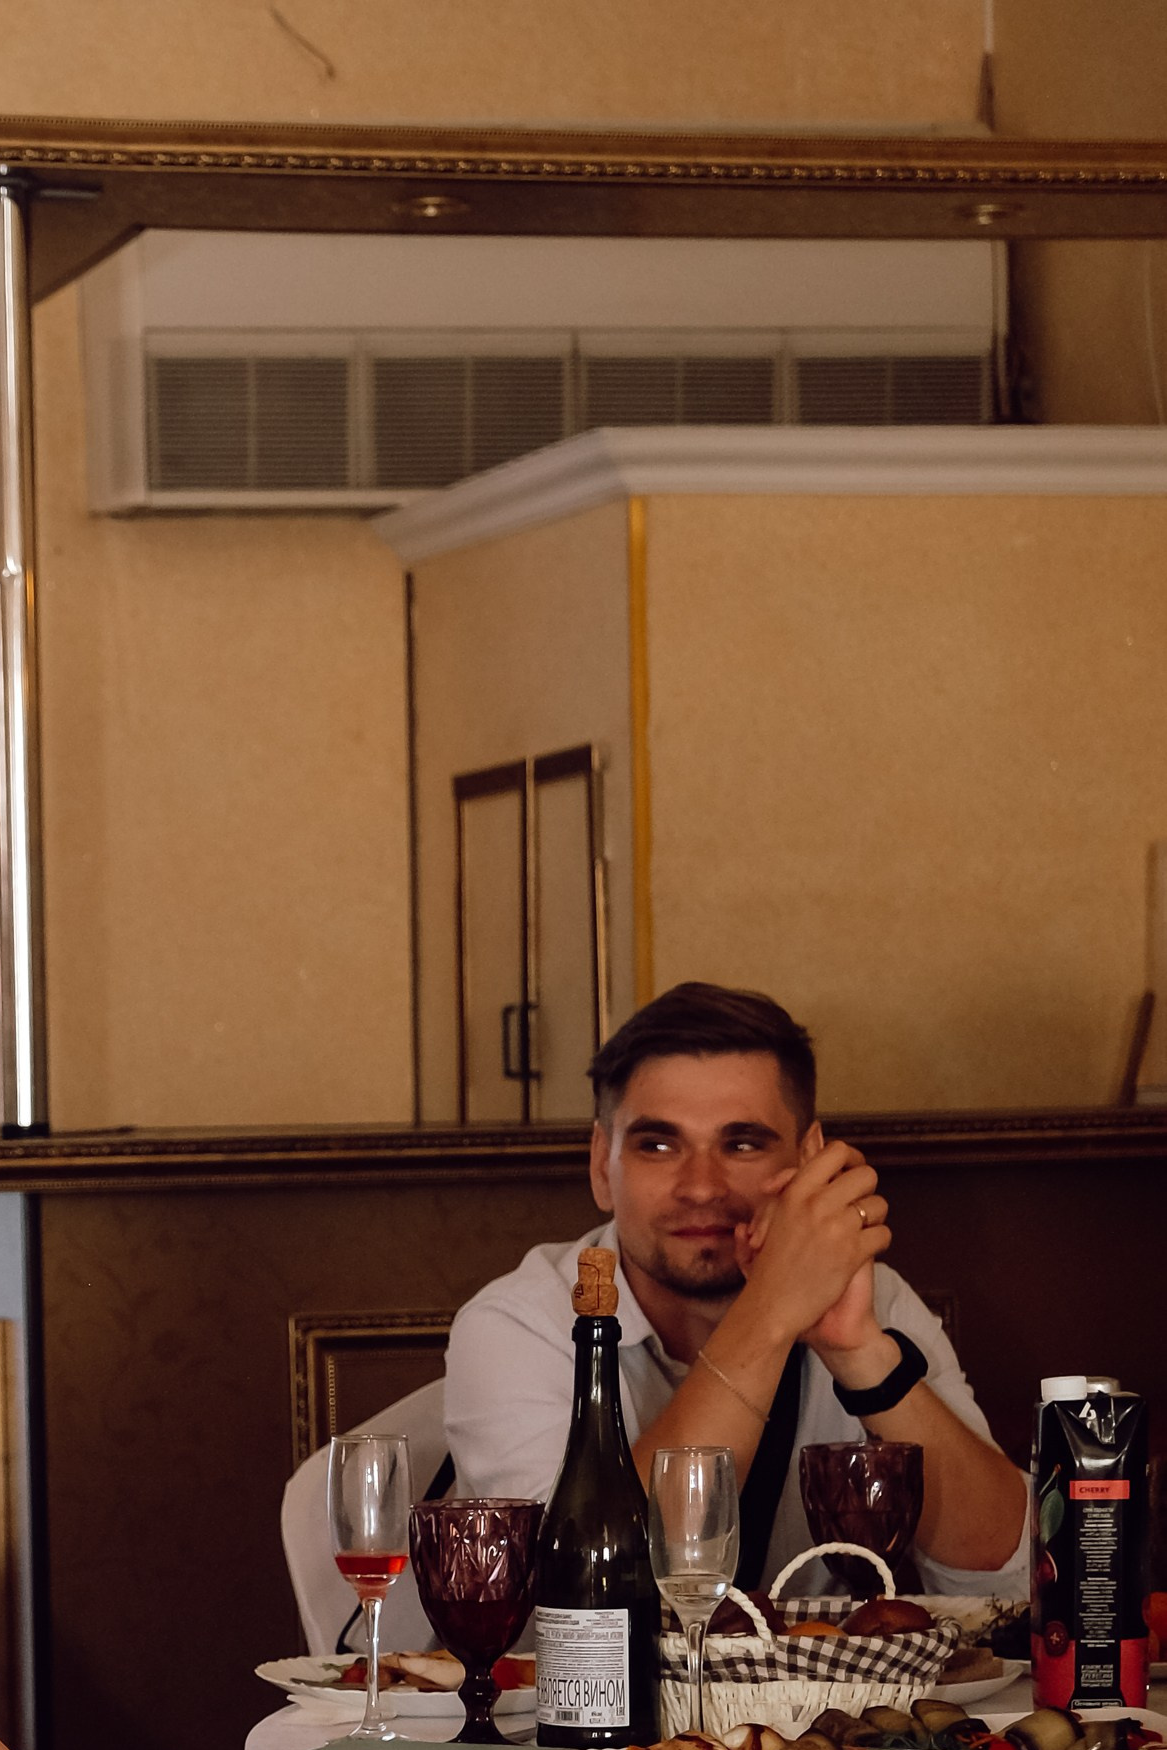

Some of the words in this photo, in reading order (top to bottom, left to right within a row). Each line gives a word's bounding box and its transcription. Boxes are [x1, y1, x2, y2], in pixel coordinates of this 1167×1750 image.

[1079, 1486, 1110, 1494] CHERRY
[540, 1677, 581, 1706] ЯВЛЯЕТСЯ
[584, 1679, 625, 1707] ВИНОМ
